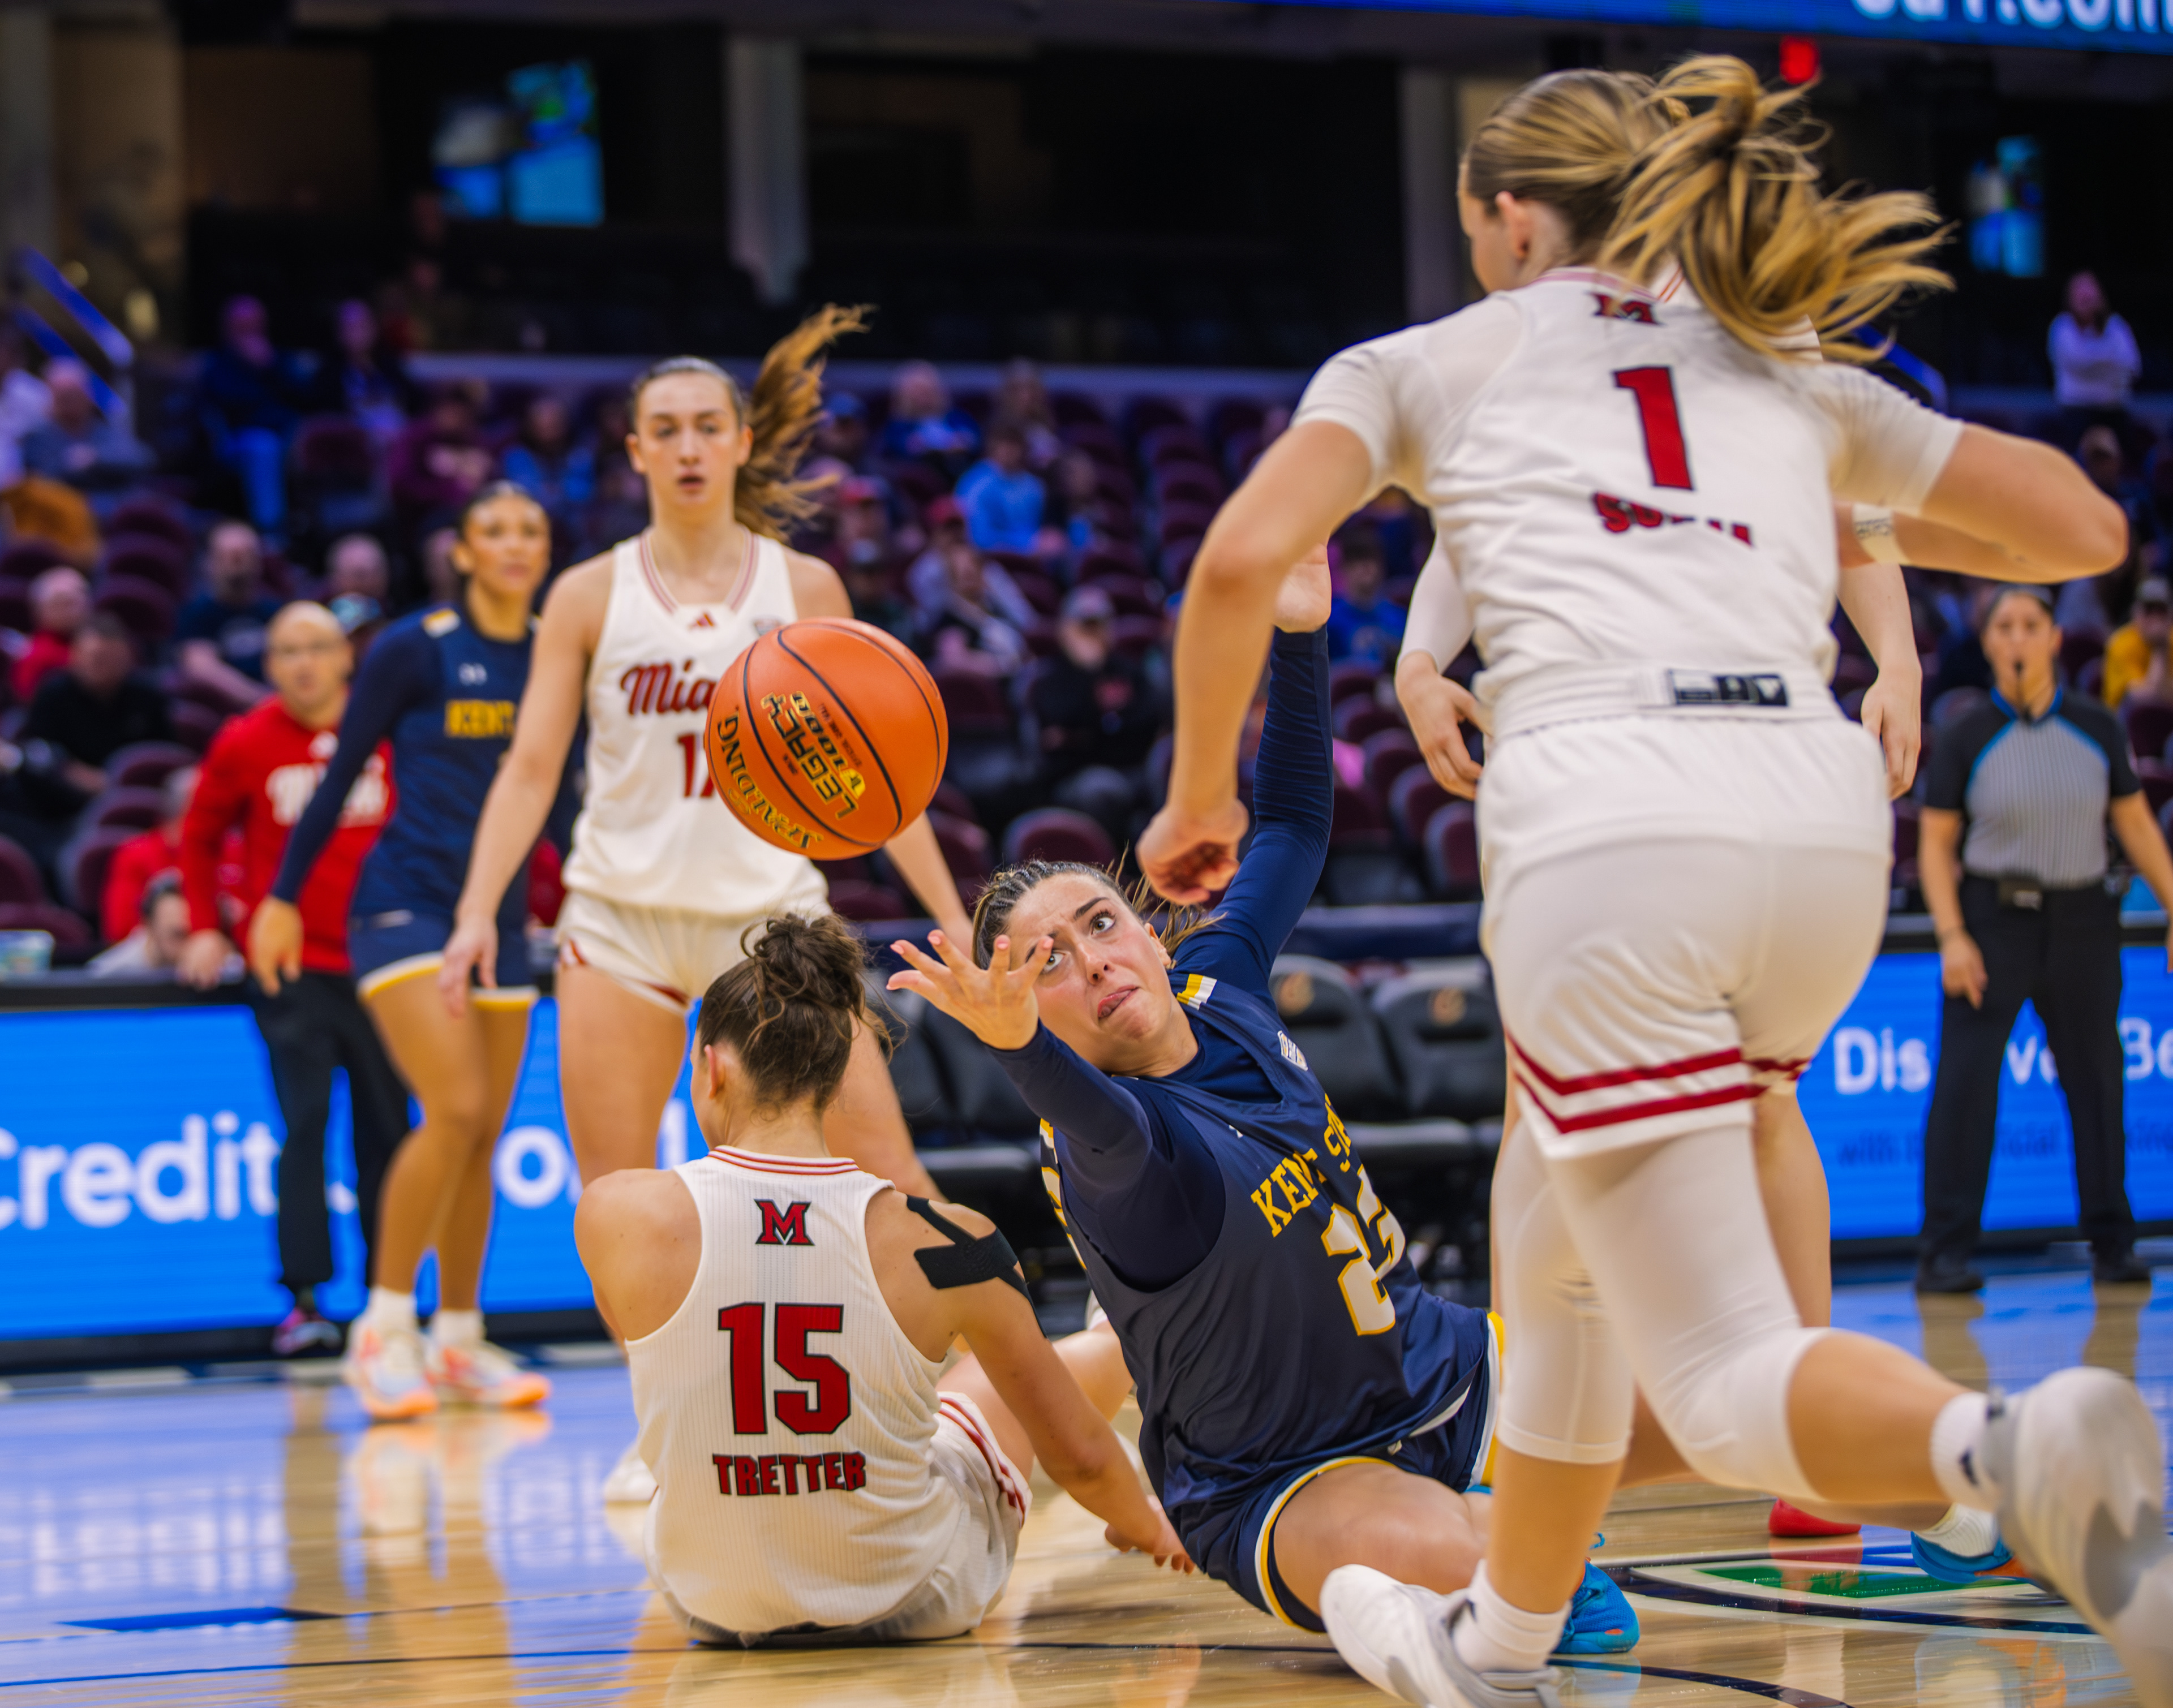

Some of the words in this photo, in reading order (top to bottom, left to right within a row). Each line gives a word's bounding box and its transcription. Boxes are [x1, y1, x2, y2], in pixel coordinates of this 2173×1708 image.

[1612, 365, 1696, 491] 1
[620, 659, 716, 715] Mia
[761, 692, 859, 820] LEGACY
[754, 1198, 815, 1246] M
[1250, 1147, 1328, 1238] KEN
[718, 1302, 852, 1435] 15
[712, 1451, 867, 1495] TRETTER
